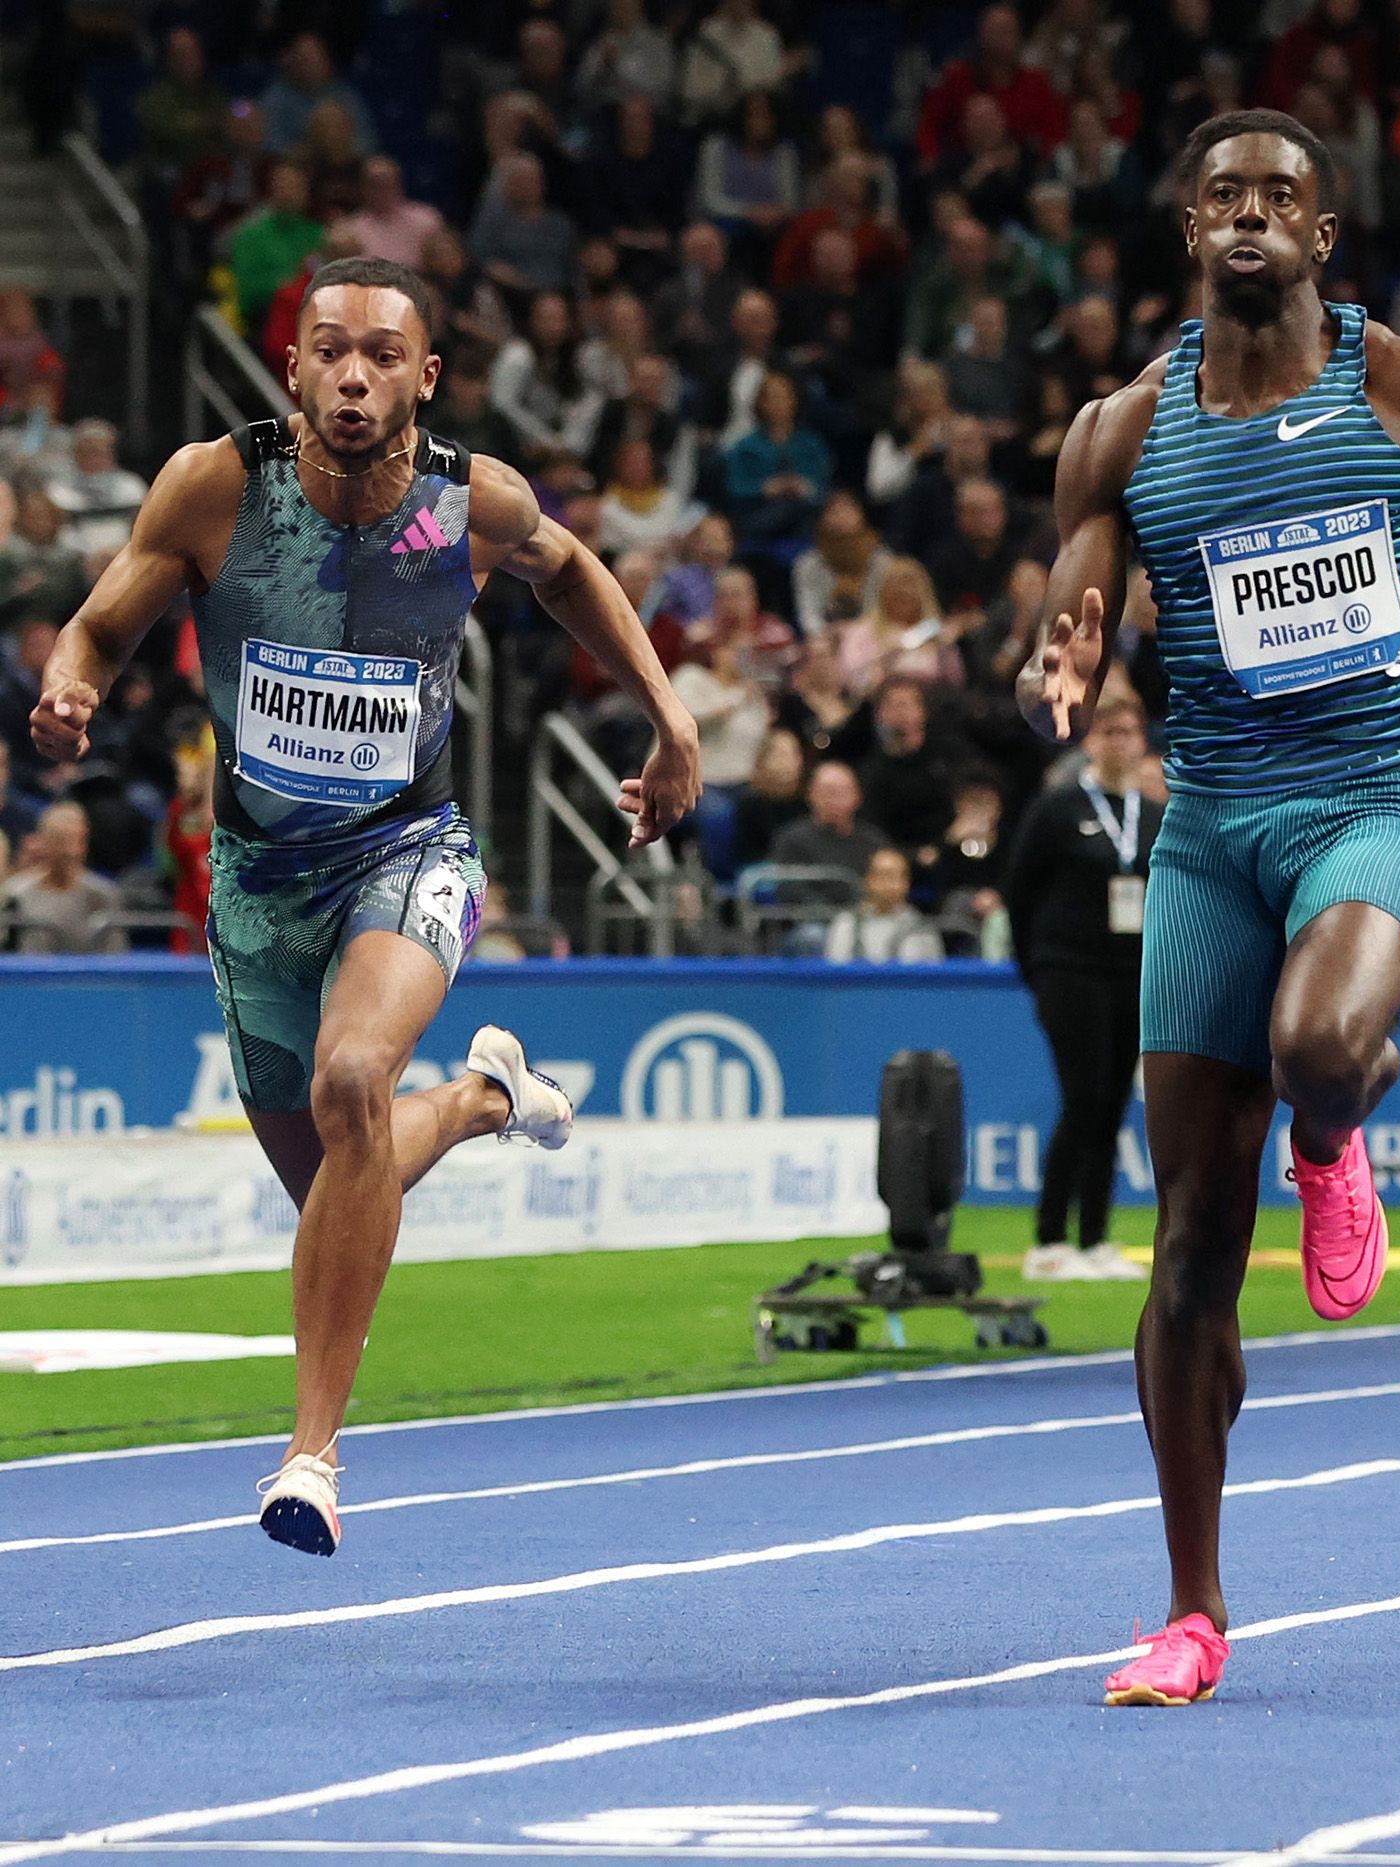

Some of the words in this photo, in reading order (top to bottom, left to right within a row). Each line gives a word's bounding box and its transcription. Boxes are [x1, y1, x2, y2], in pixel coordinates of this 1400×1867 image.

[1219, 531, 1272, 557] BERLIN
[1324, 510, 1371, 537] 2023
[1231, 546, 1377, 616] PRESCOD
[1258, 618, 1339, 649] Allianz
[258, 645, 307, 672] BERLIN
[362, 661, 405, 680] 2023
[1333, 654, 1365, 670] BERLIN
[250, 675, 408, 734] HARTMANN
[267, 733, 345, 764] Allianz
[328, 786, 360, 797] BERLIN
[0, 1065, 126, 1138] rlin
